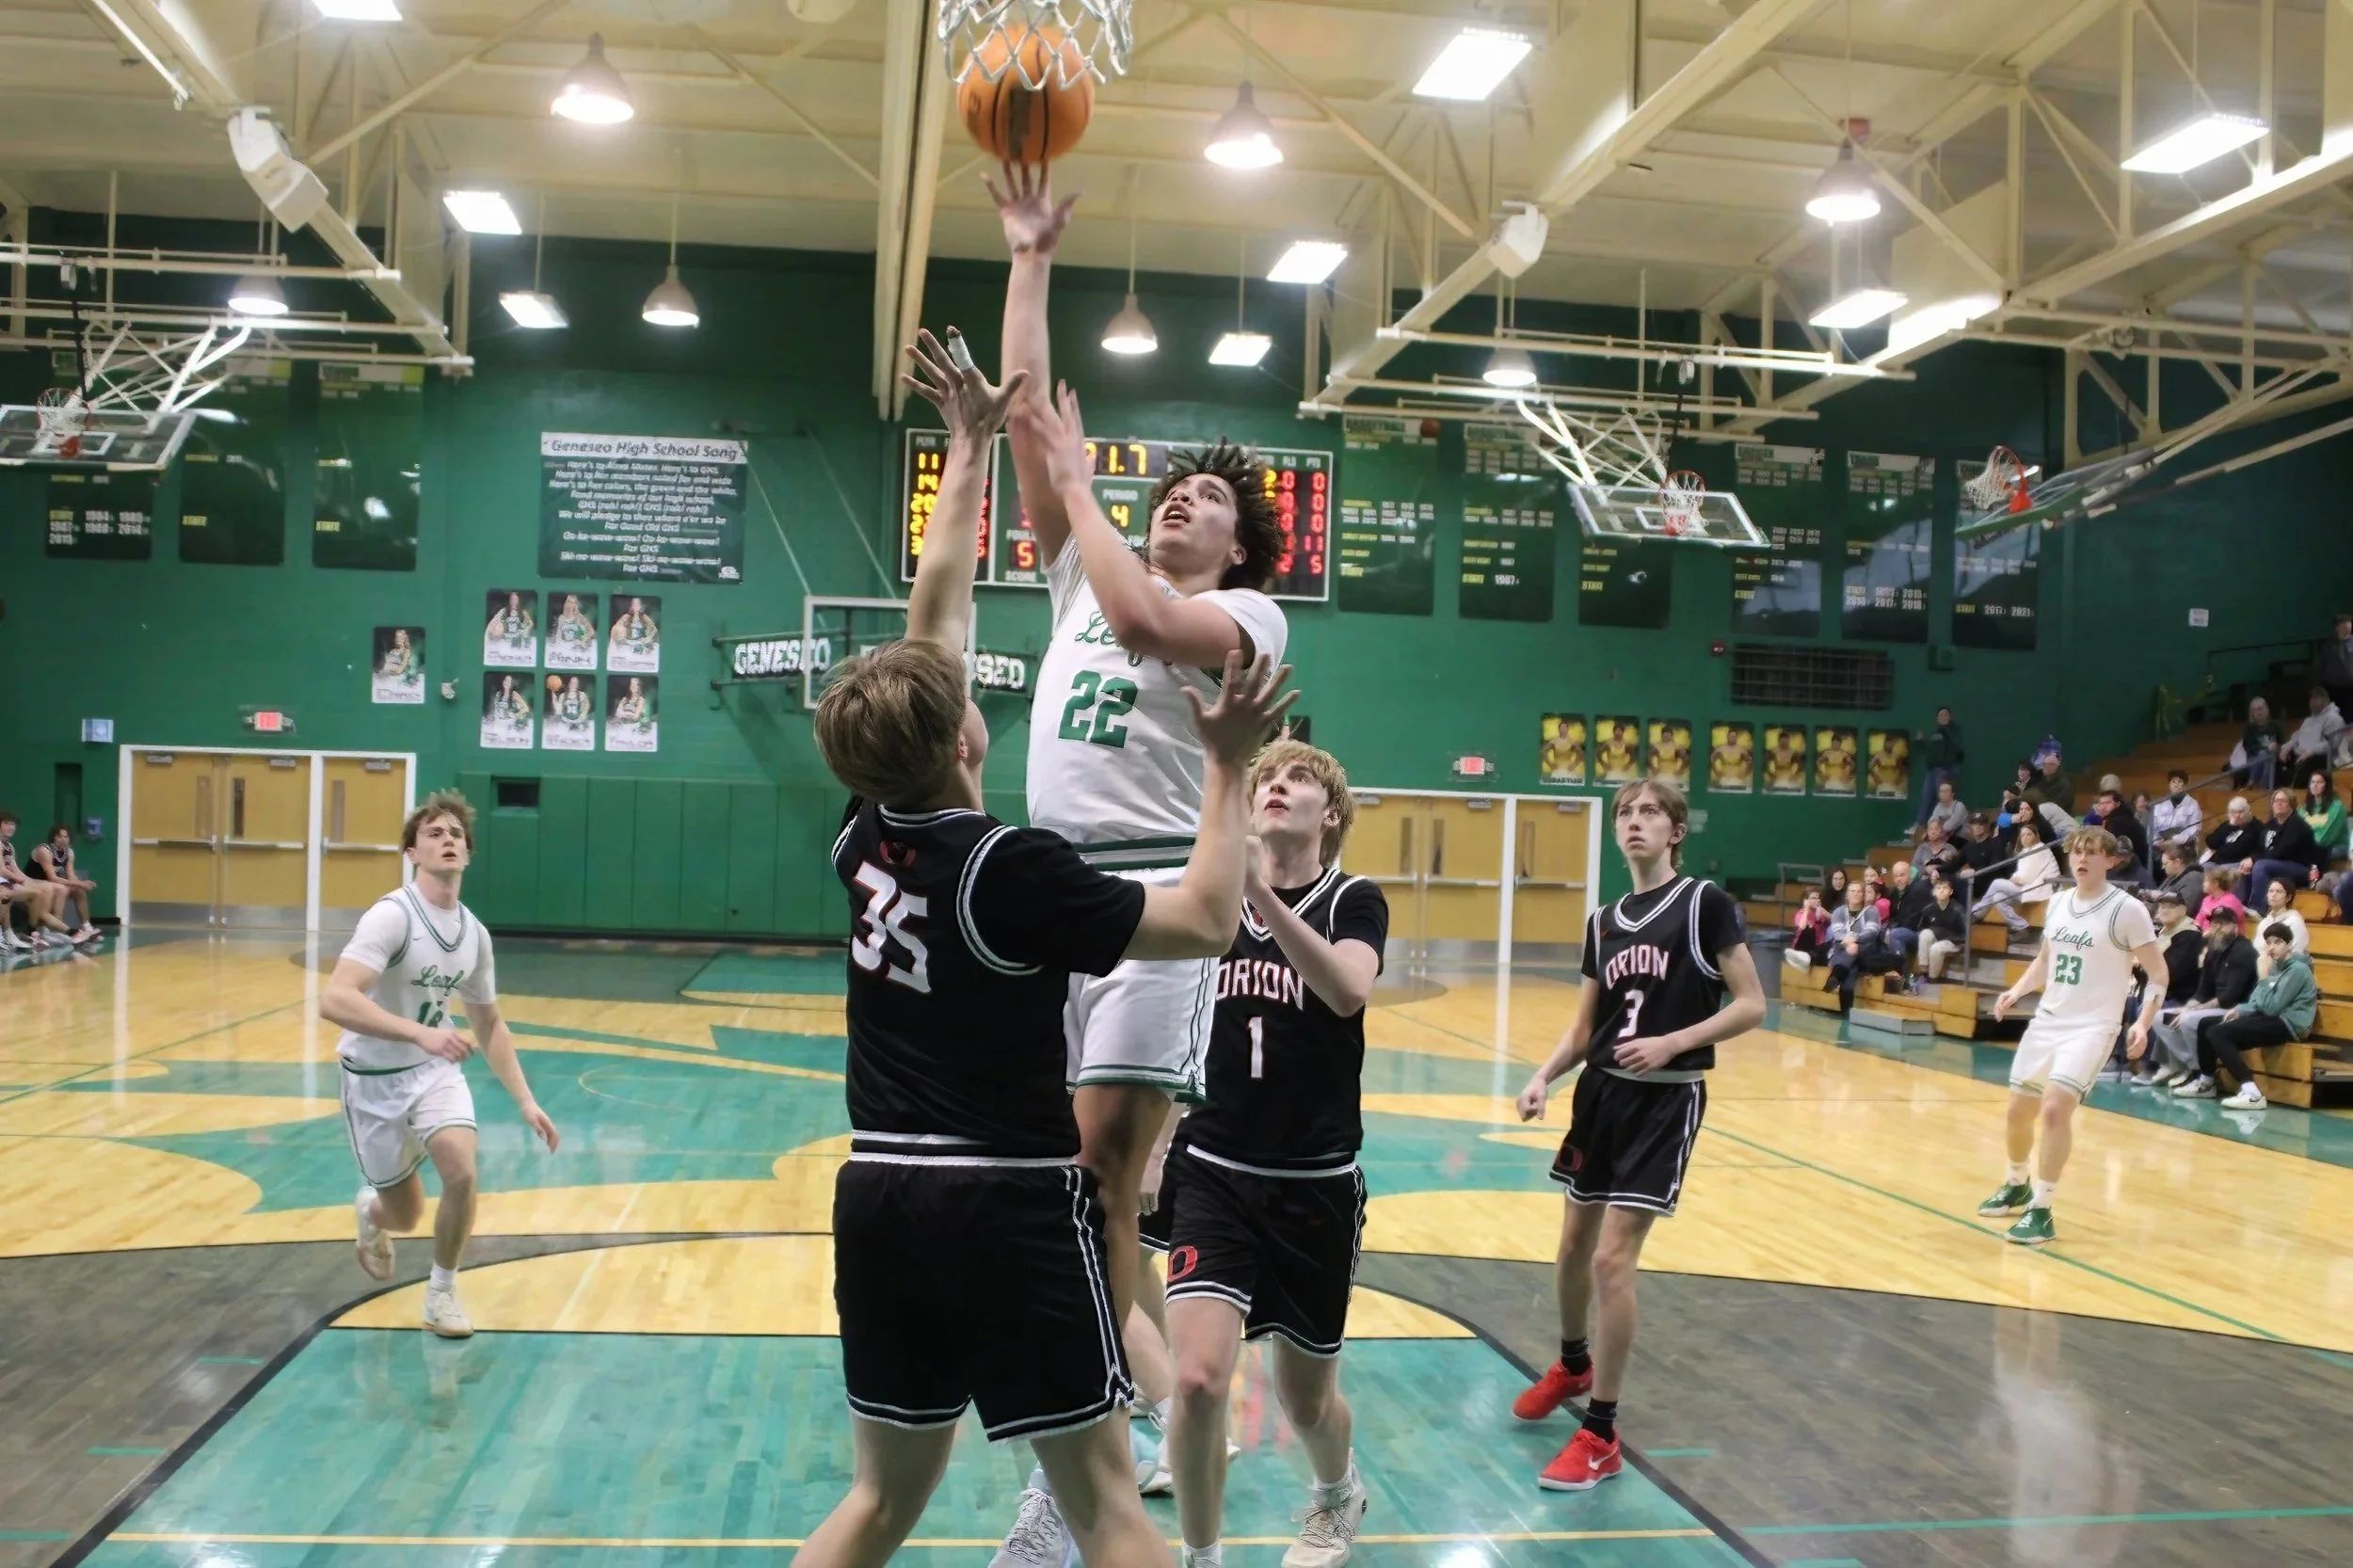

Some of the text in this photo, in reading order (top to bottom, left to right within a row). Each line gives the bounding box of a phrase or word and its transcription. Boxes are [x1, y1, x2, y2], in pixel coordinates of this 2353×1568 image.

[551, 440, 738, 462] Geneseo High School Song
[919, 453, 938, 470] 11
[918, 473, 938, 491] 14
[1313, 472, 1325, 492] 0
[910, 493, 937, 513] 20
[1312, 493, 1325, 513] 0
[1111, 504, 1129, 527] 4
[1311, 514, 1324, 534] 0
[1016, 541, 1035, 568] 5
[1305, 535, 1323, 552] 11
[1310, 554, 1323, 575] 5
[1058, 669, 1138, 748] 22
[853, 860, 932, 994] 35
[2052, 925, 2094, 951] Leafs
[1606, 944, 1670, 990] ORION
[2055, 953, 2083, 985] 23
[410, 965, 464, 997] Leaf
[1215, 958, 1305, 1012] ORION
[1618, 988, 1645, 1038] 3
[1247, 1016, 1263, 1079] 1
